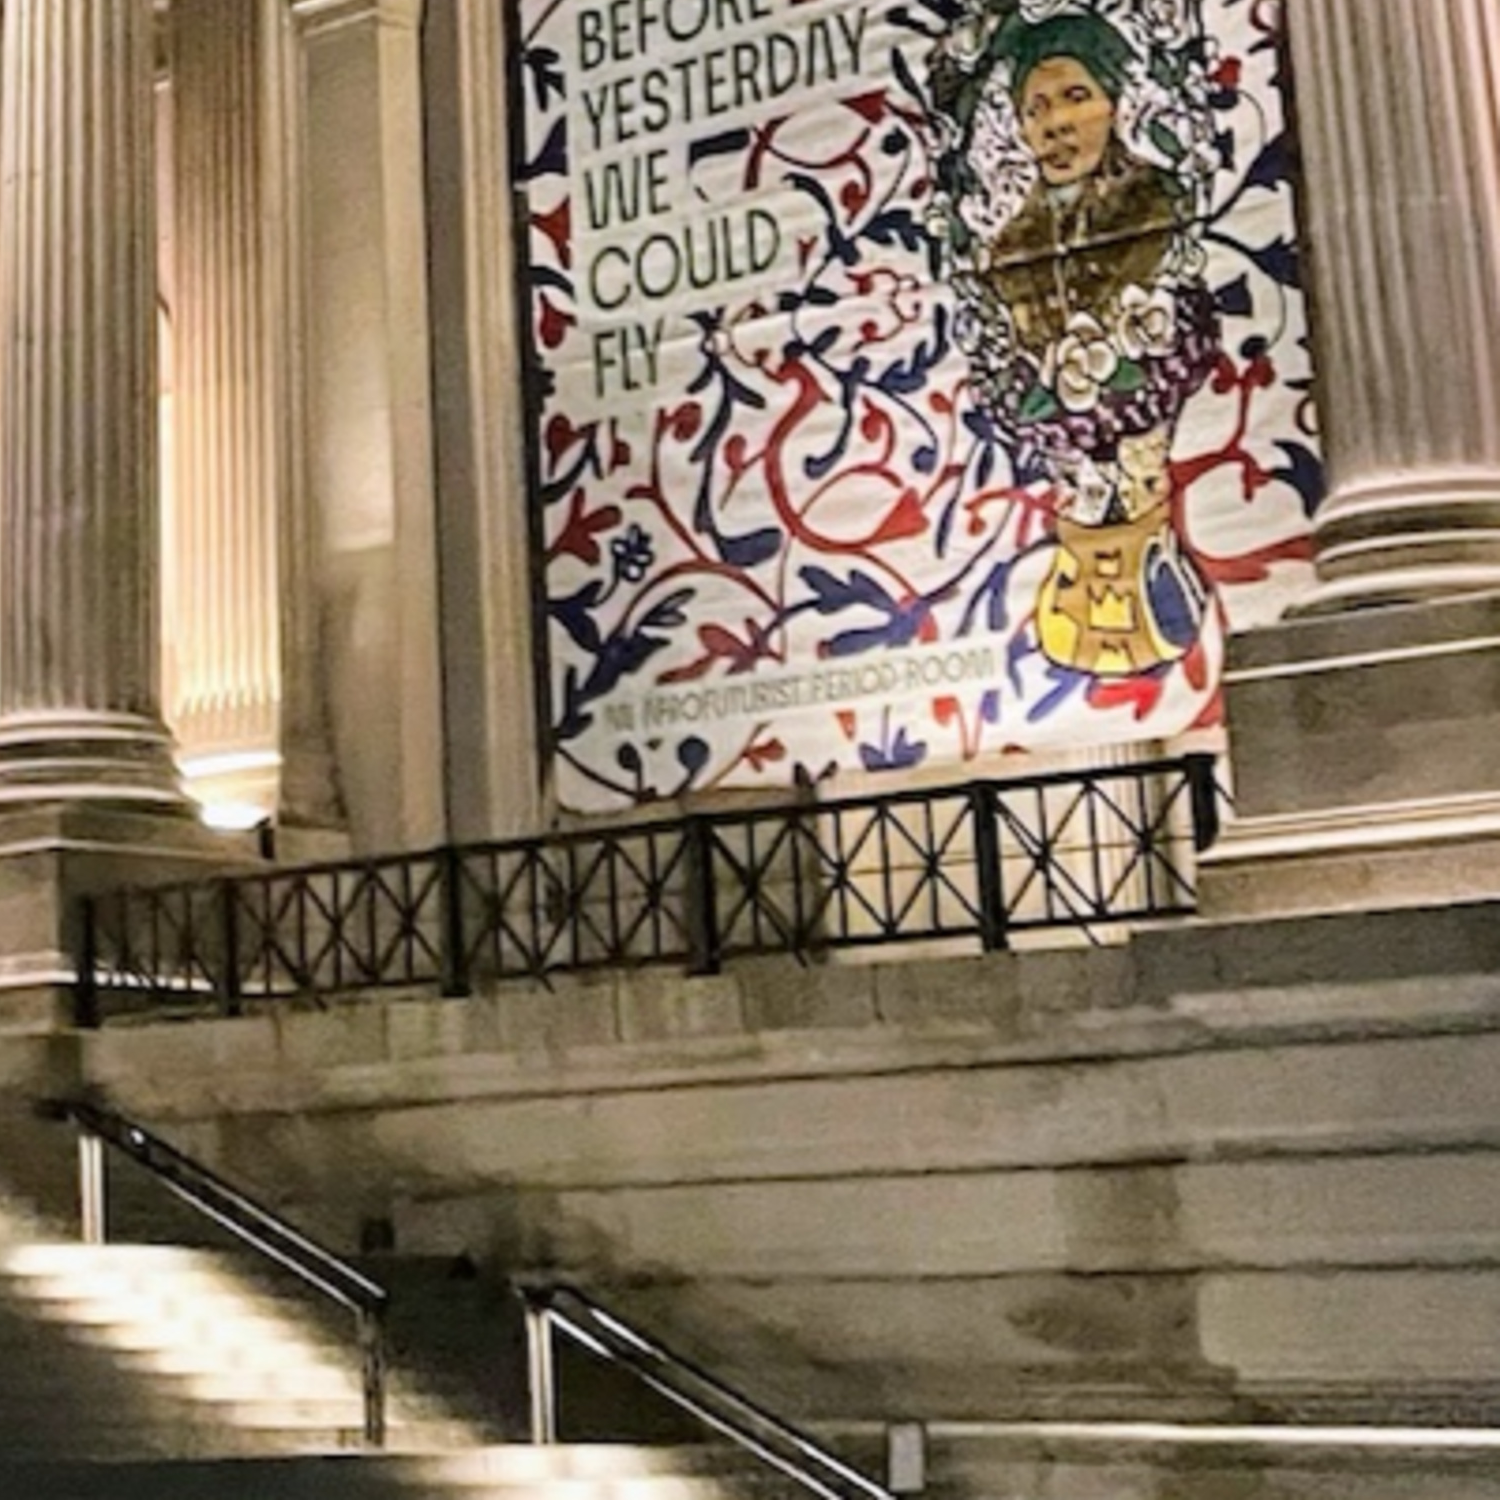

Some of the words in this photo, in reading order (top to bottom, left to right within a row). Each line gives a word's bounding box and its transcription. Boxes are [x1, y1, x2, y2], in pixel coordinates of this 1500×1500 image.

[581, 6, 869, 150] YESTERDAY
[584, 149, 672, 231] WE
[588, 209, 781, 311] COULD
[593, 316, 665, 399] FLY
[812, 662, 896, 703] PERIOD
[904, 648, 995, 690] ROOM
